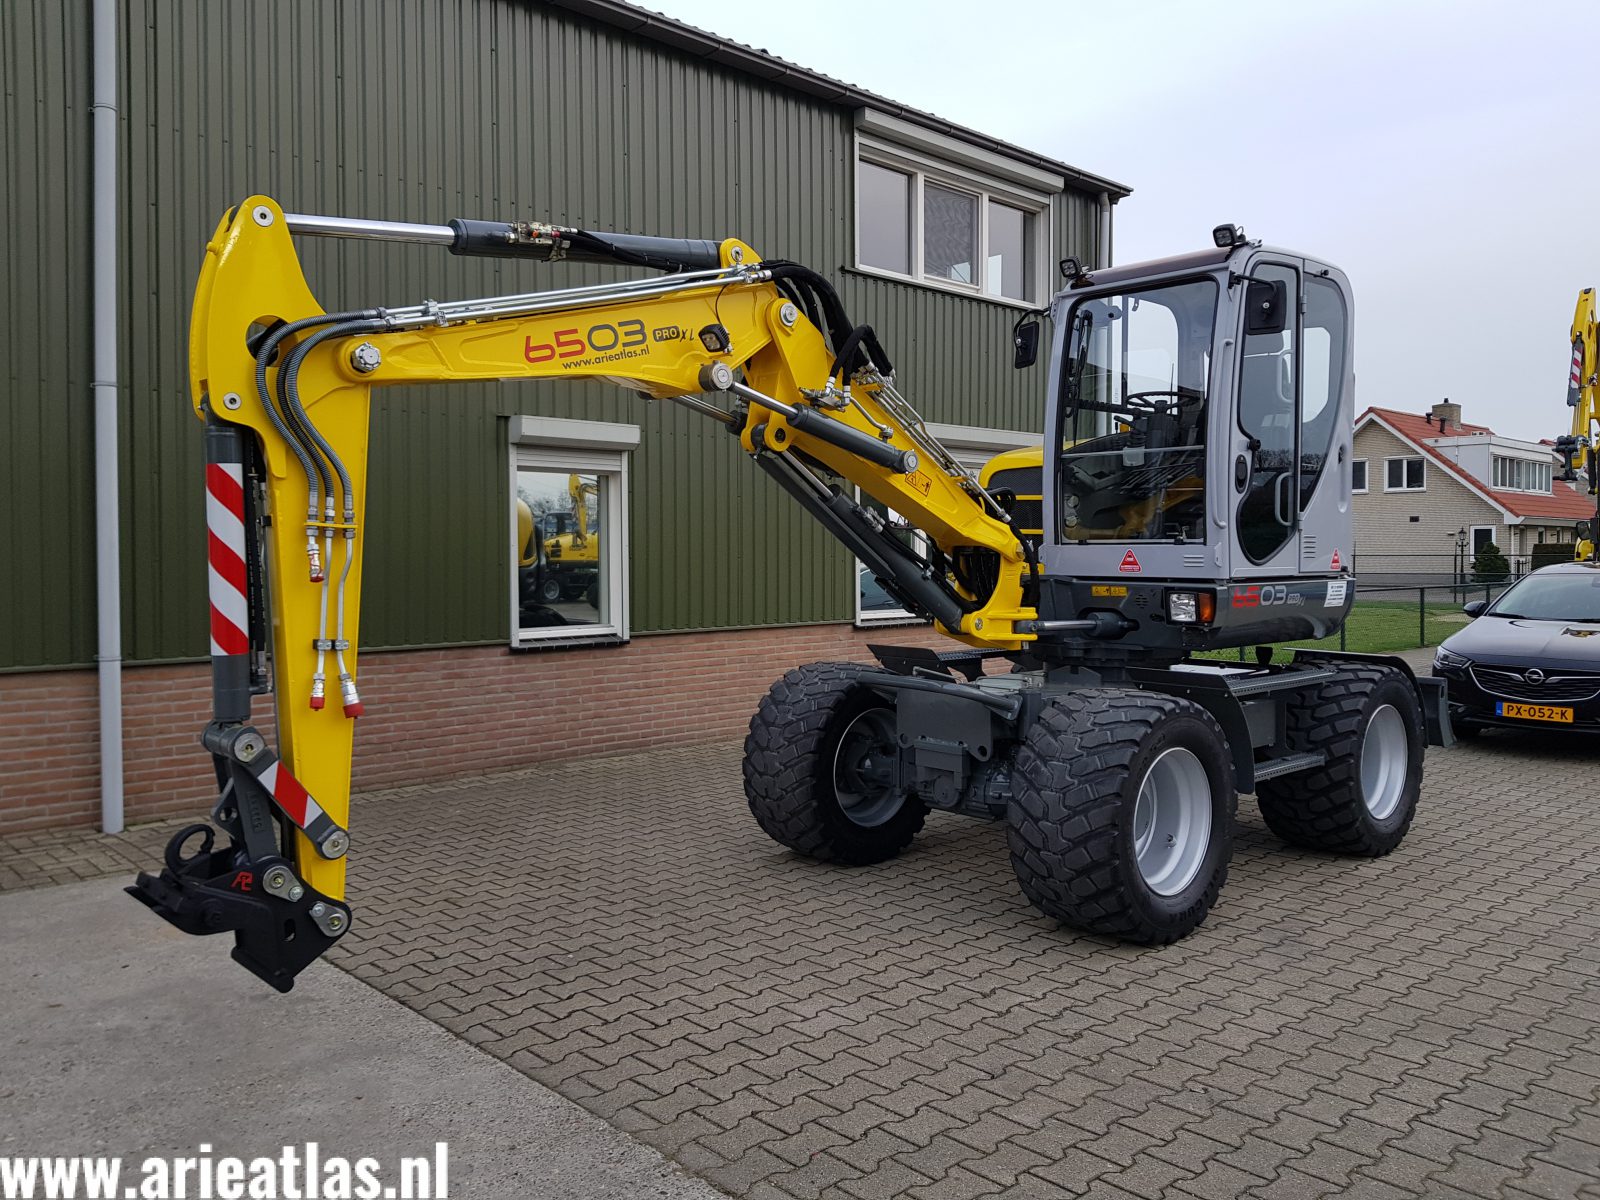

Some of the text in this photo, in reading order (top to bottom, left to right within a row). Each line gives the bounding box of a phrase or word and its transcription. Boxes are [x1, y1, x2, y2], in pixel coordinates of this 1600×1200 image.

[524, 319, 647, 363] 6503
[655, 328, 678, 340] PRO
[562, 345, 650, 370] www.arieatlas.nl
[1232, 585, 1287, 608] 6503
[1507, 705, 1568, 720] PX-052-K
